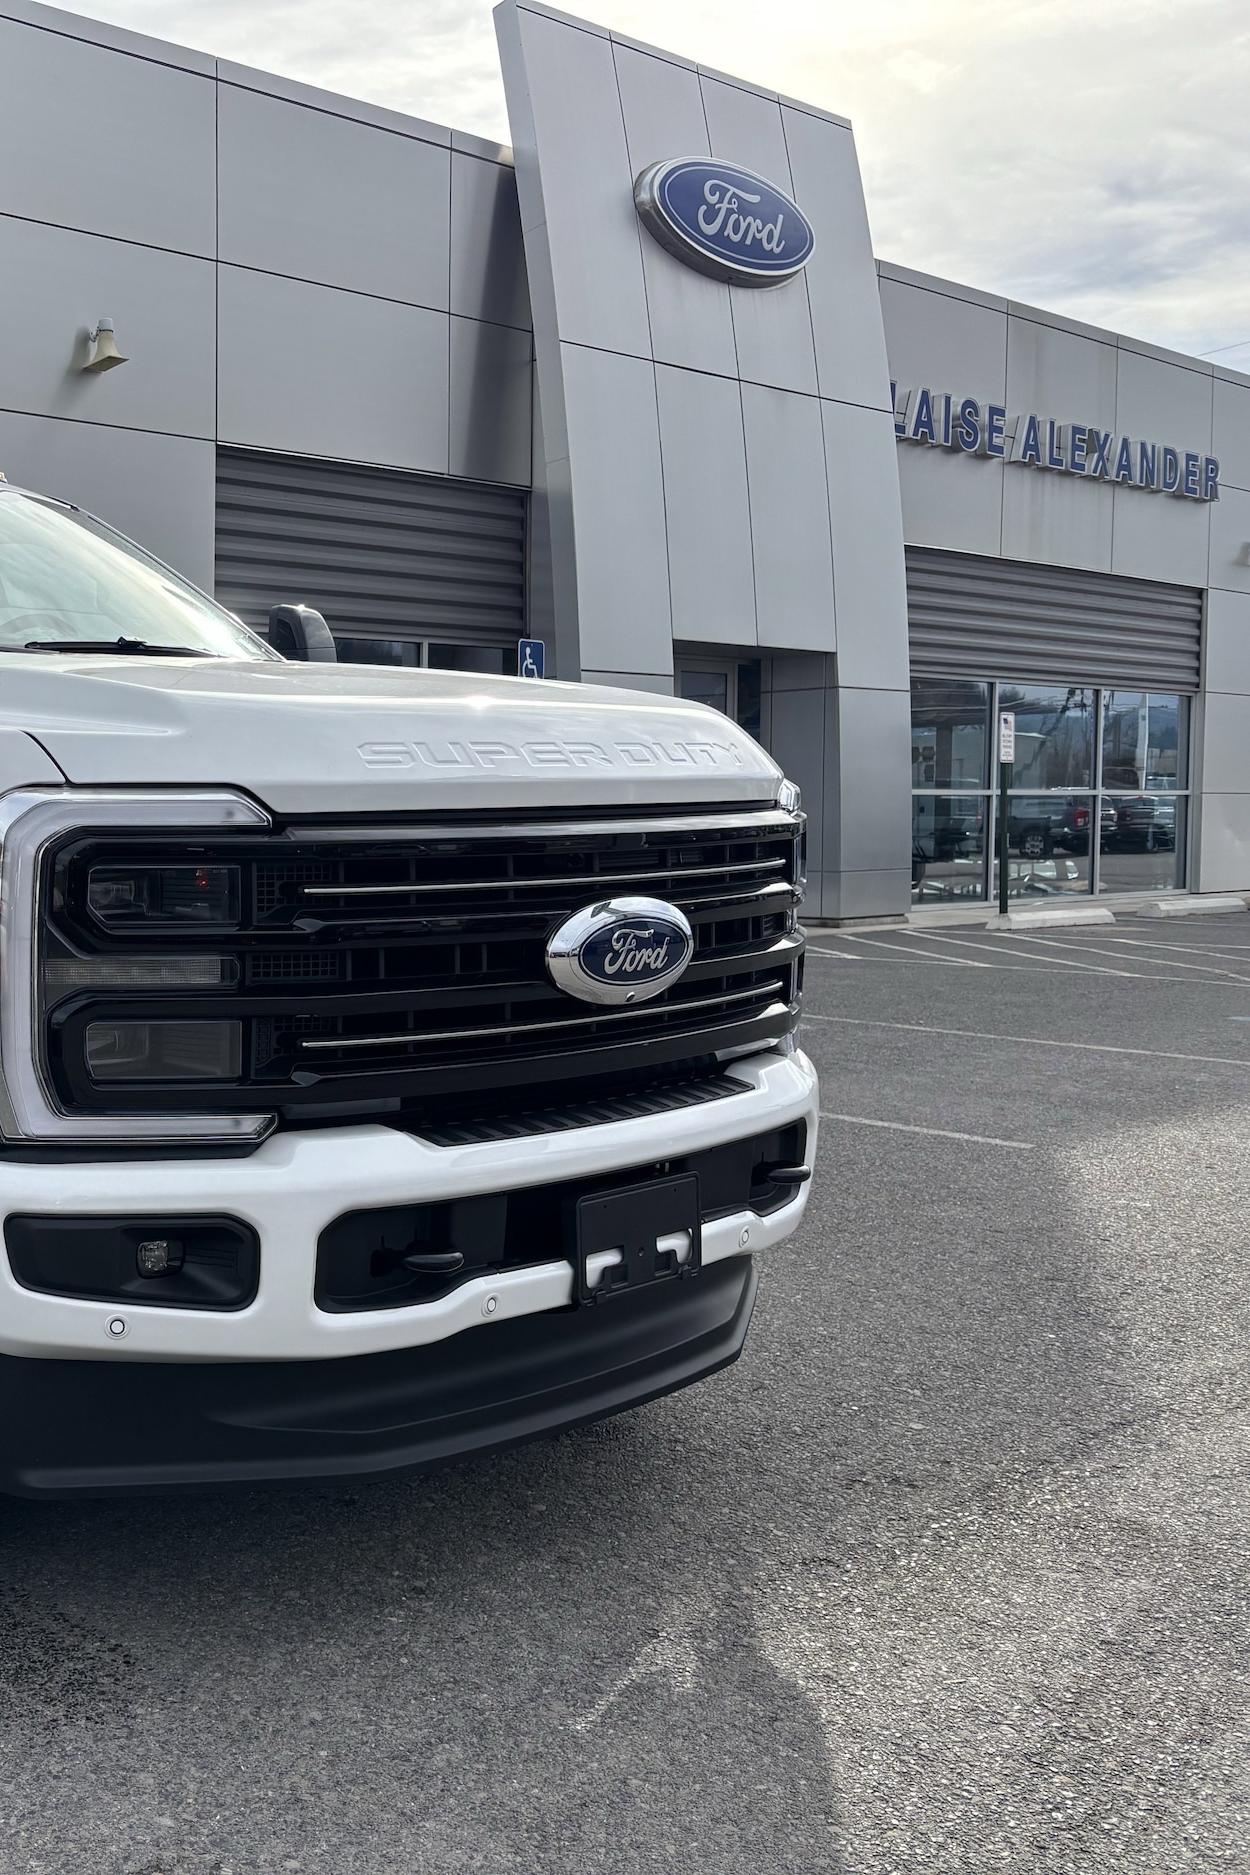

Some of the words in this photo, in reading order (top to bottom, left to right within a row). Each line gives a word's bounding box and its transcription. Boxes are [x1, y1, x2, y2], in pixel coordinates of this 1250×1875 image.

[697, 179, 786, 255] Ford
[1019, 412, 1221, 501] ALEXANDER
[356, 740, 613, 769] SUPER
[614, 741, 744, 767] DUTY
[604, 928, 671, 975] Ford
